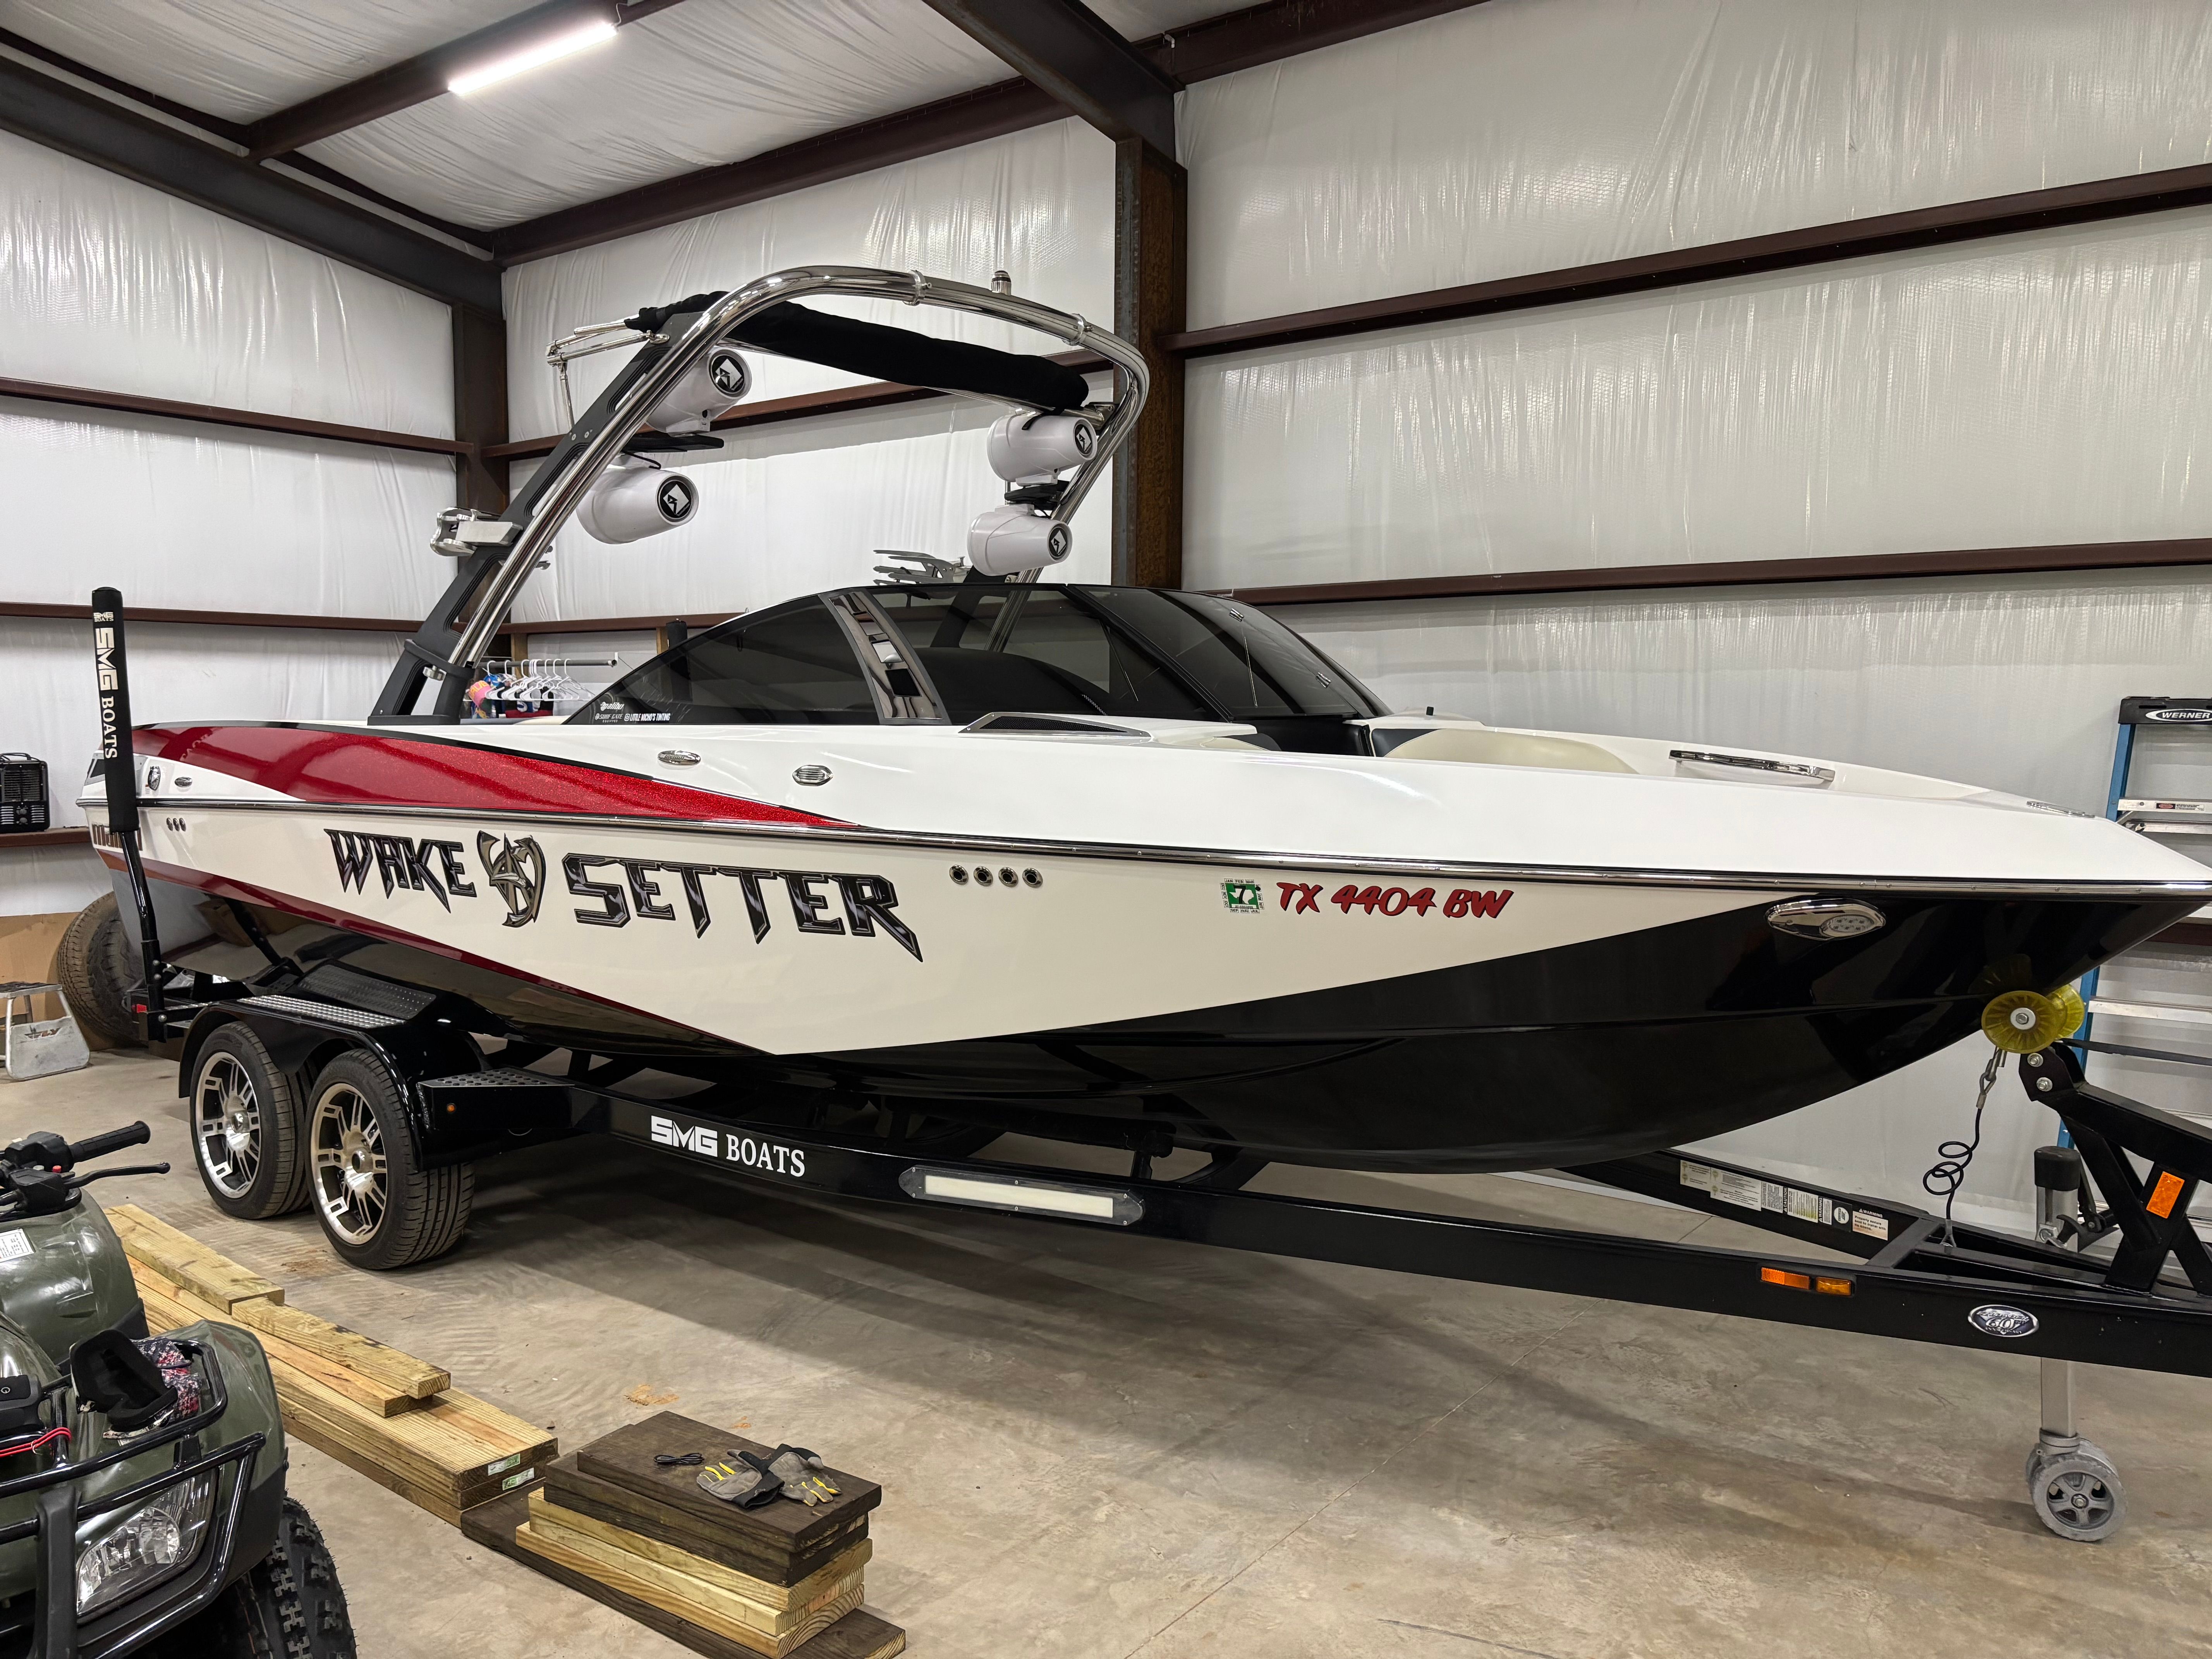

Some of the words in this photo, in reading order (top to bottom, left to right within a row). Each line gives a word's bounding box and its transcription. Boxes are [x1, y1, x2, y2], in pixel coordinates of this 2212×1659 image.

[95, 627, 118, 690] SMG
[101, 696, 117, 759] BOATS
[656, 713, 671, 721] TINTING
[323, 828, 477, 914] WAKE
[1276, 882, 1324, 915] TX
[1330, 884, 1436, 917] 4404
[1442, 889, 1514, 919] BW
[561, 852, 923, 962] SETTER
[651, 1115, 718, 1157] SMG
[726, 1133, 805, 1177] BOATS
[1863, 1209, 1883, 1218] WARNING
